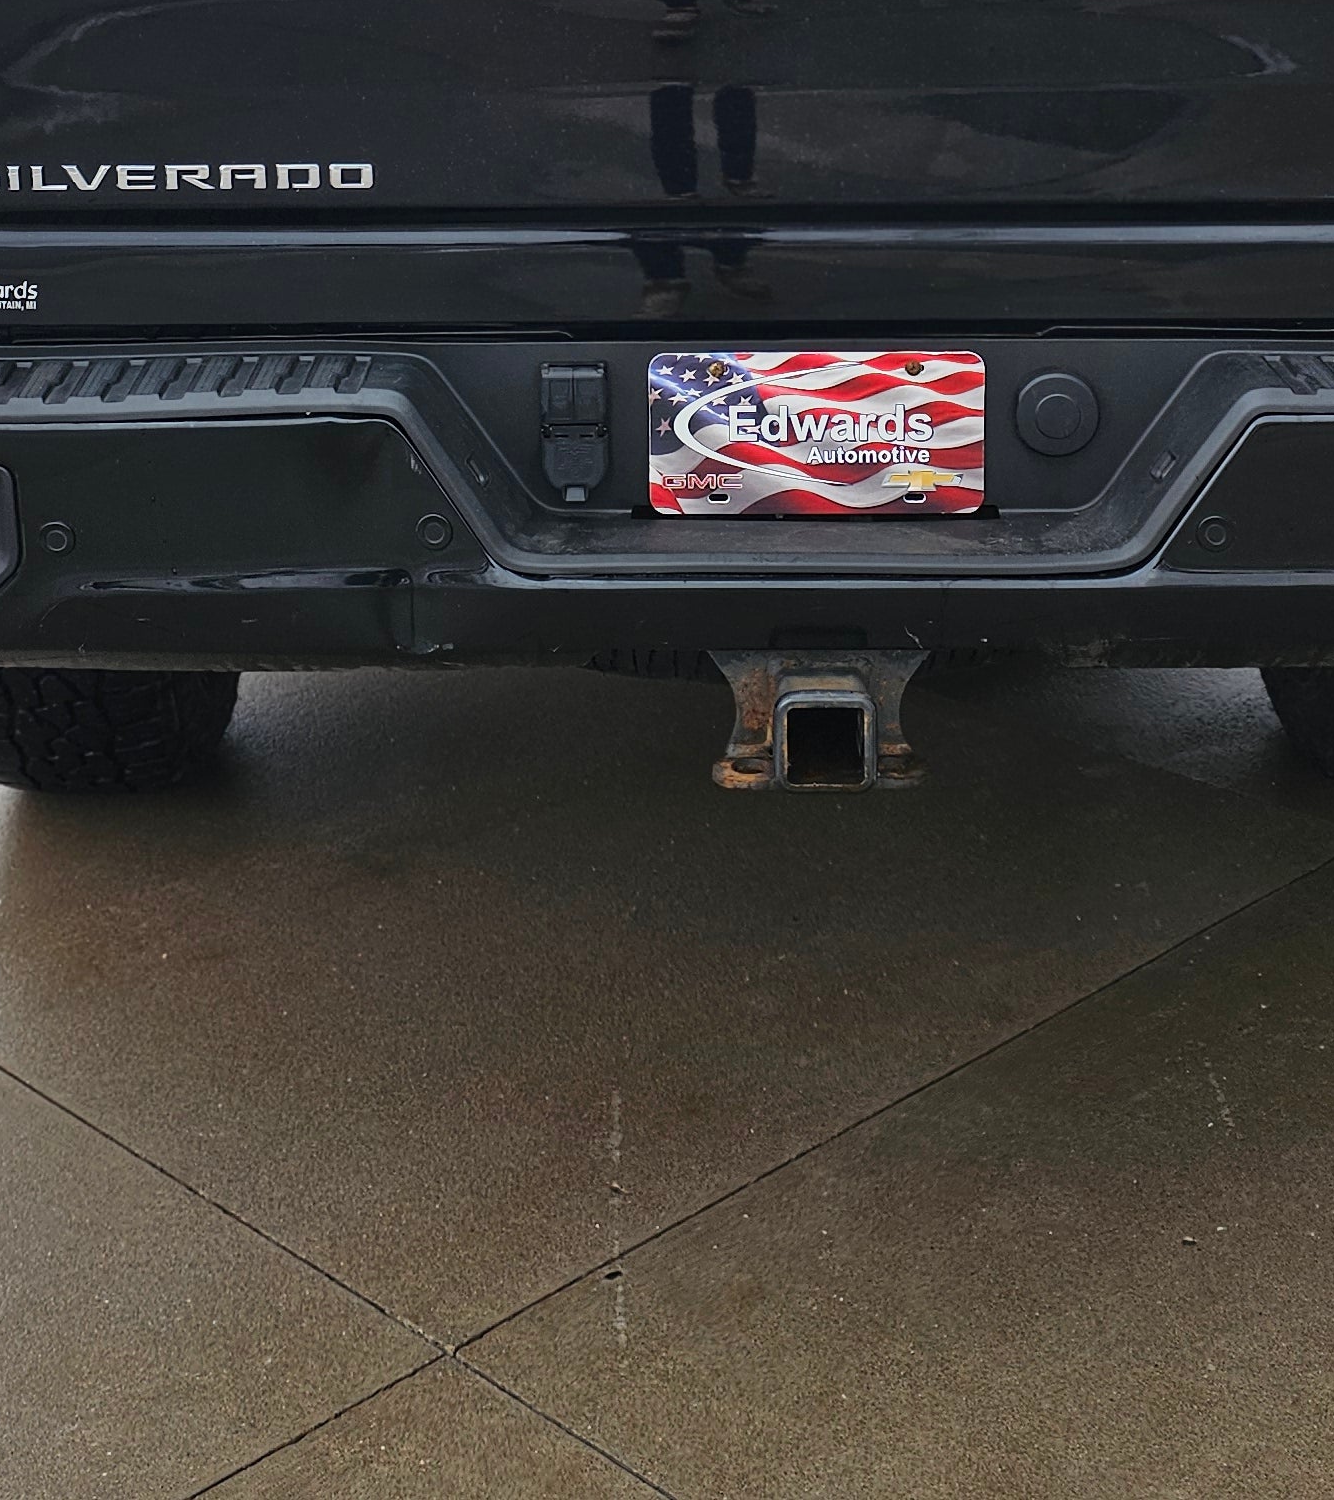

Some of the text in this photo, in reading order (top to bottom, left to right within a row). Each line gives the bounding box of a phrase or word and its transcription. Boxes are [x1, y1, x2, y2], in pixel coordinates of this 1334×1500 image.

[26, 300, 37, 310] MI
[727, 404, 934, 443] Edwards
[806, 445, 931, 464] Automotive
[662, 473, 744, 490] GMC
